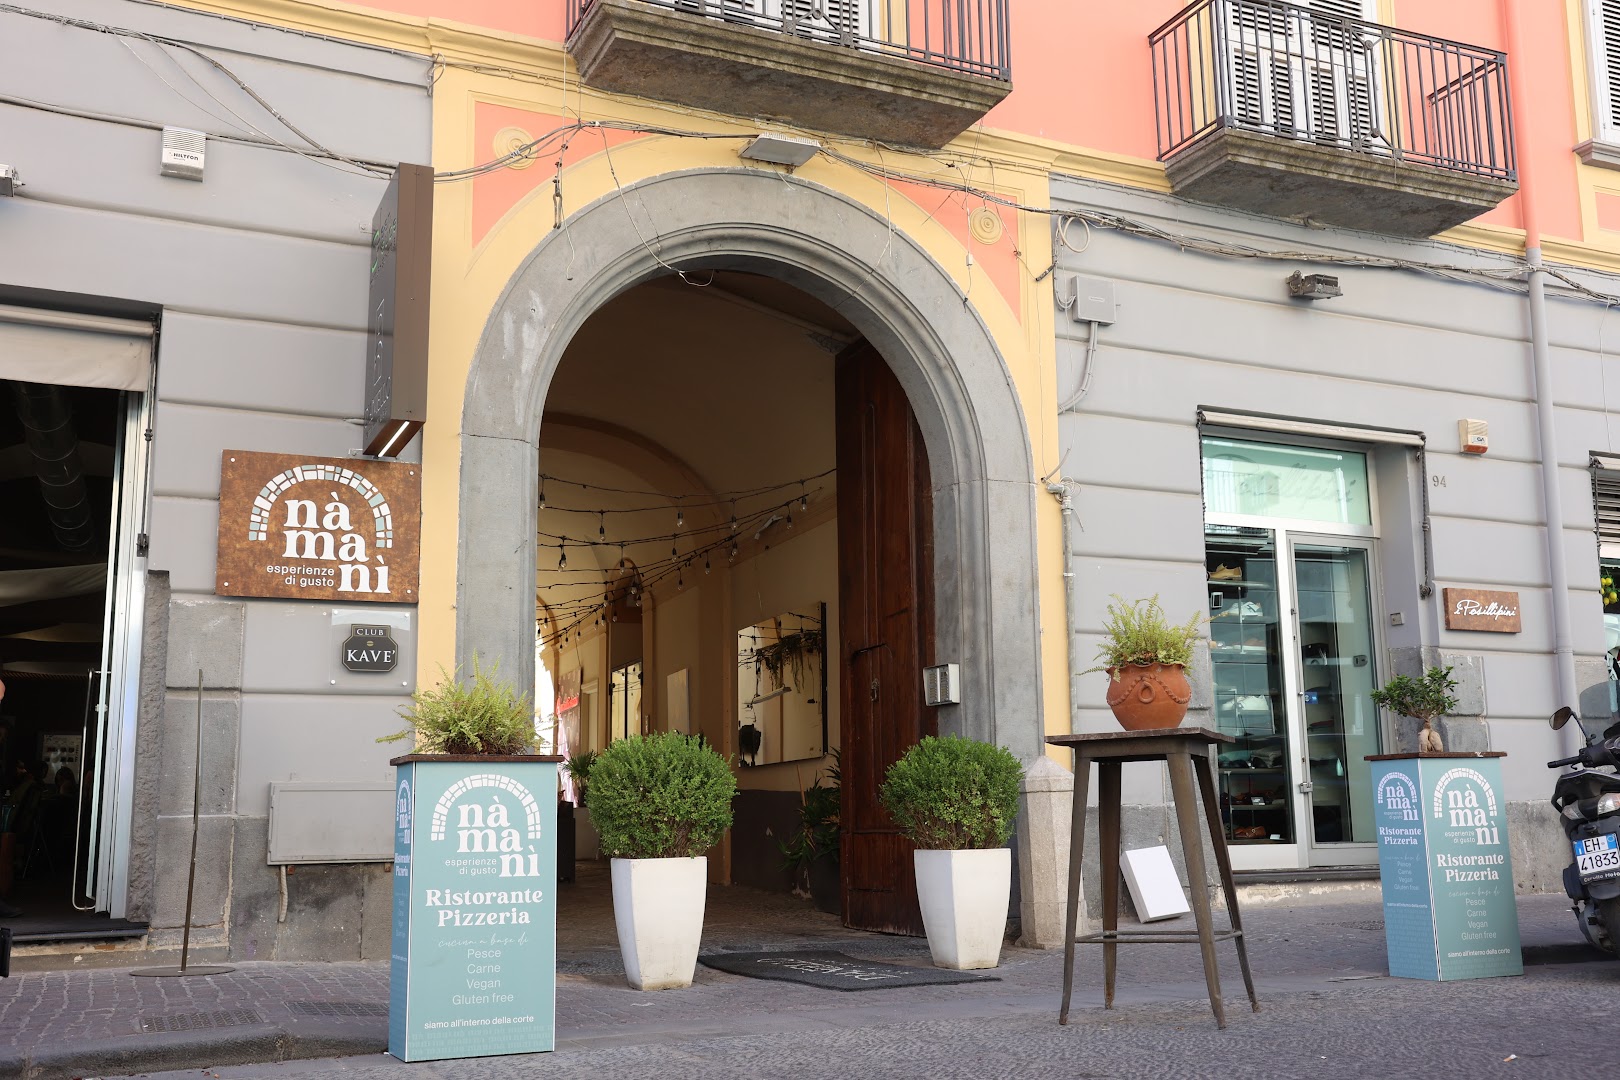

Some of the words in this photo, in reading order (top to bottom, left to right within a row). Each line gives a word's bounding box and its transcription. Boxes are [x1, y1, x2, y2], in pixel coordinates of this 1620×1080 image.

[1432, 475, 1446, 488] 94
[284, 492, 353, 531] nà
[282, 530, 369, 562] ma
[267, 565, 334, 576] esperienze
[337, 555, 391, 593] nì
[285, 575, 296, 585] di
[300, 577, 334, 587] gusto
[356, 628, 383, 636] CLUB
[1386, 782, 1405, 797] nà
[1447, 784, 1479, 808] nà
[1387, 798, 1411, 809] ma
[458, 796, 510, 828] nà
[1403, 806, 1419, 820] nì
[1449, 808, 1488, 826] ma
[1379, 827, 1422, 835] Ristorante
[1475, 821, 1500, 845] nì
[457, 828, 523, 852] ma
[1384, 836, 1418, 844] Pizzeria
[1584, 838, 1600, 852] EH
[445, 857, 497, 867] esperienze
[499, 845, 540, 877] nì
[1437, 854, 1504, 867] Ristorante
[1581, 852, 1619, 870] 41833
[459, 866, 468, 875] di
[470, 866, 497, 876] gusto
[1445, 868, 1499, 882] Pizzeria
[425, 889, 544, 907] Ristorante
[1466, 898, 1485, 906] Pesce
[438, 908, 530, 927] Pizzeria
[1467, 909, 1486, 917] Carne
[1468, 921, 1488, 929] Vegan
[1462, 932, 1483, 941] Gluten
[1484, 931, 1497, 939] free
[468, 948, 501, 959] Pesce
[467, 964, 501, 974] Carne
[466, 979, 501, 990] Vegan
[452, 994, 489, 1005] Gluten
[492, 992, 514, 1002] free
[424, 1020, 449, 1029] siamo
[451, 1018, 490, 1027] all'interno
[492, 1017, 511, 1025] della
[513, 1015, 534, 1023] corte
